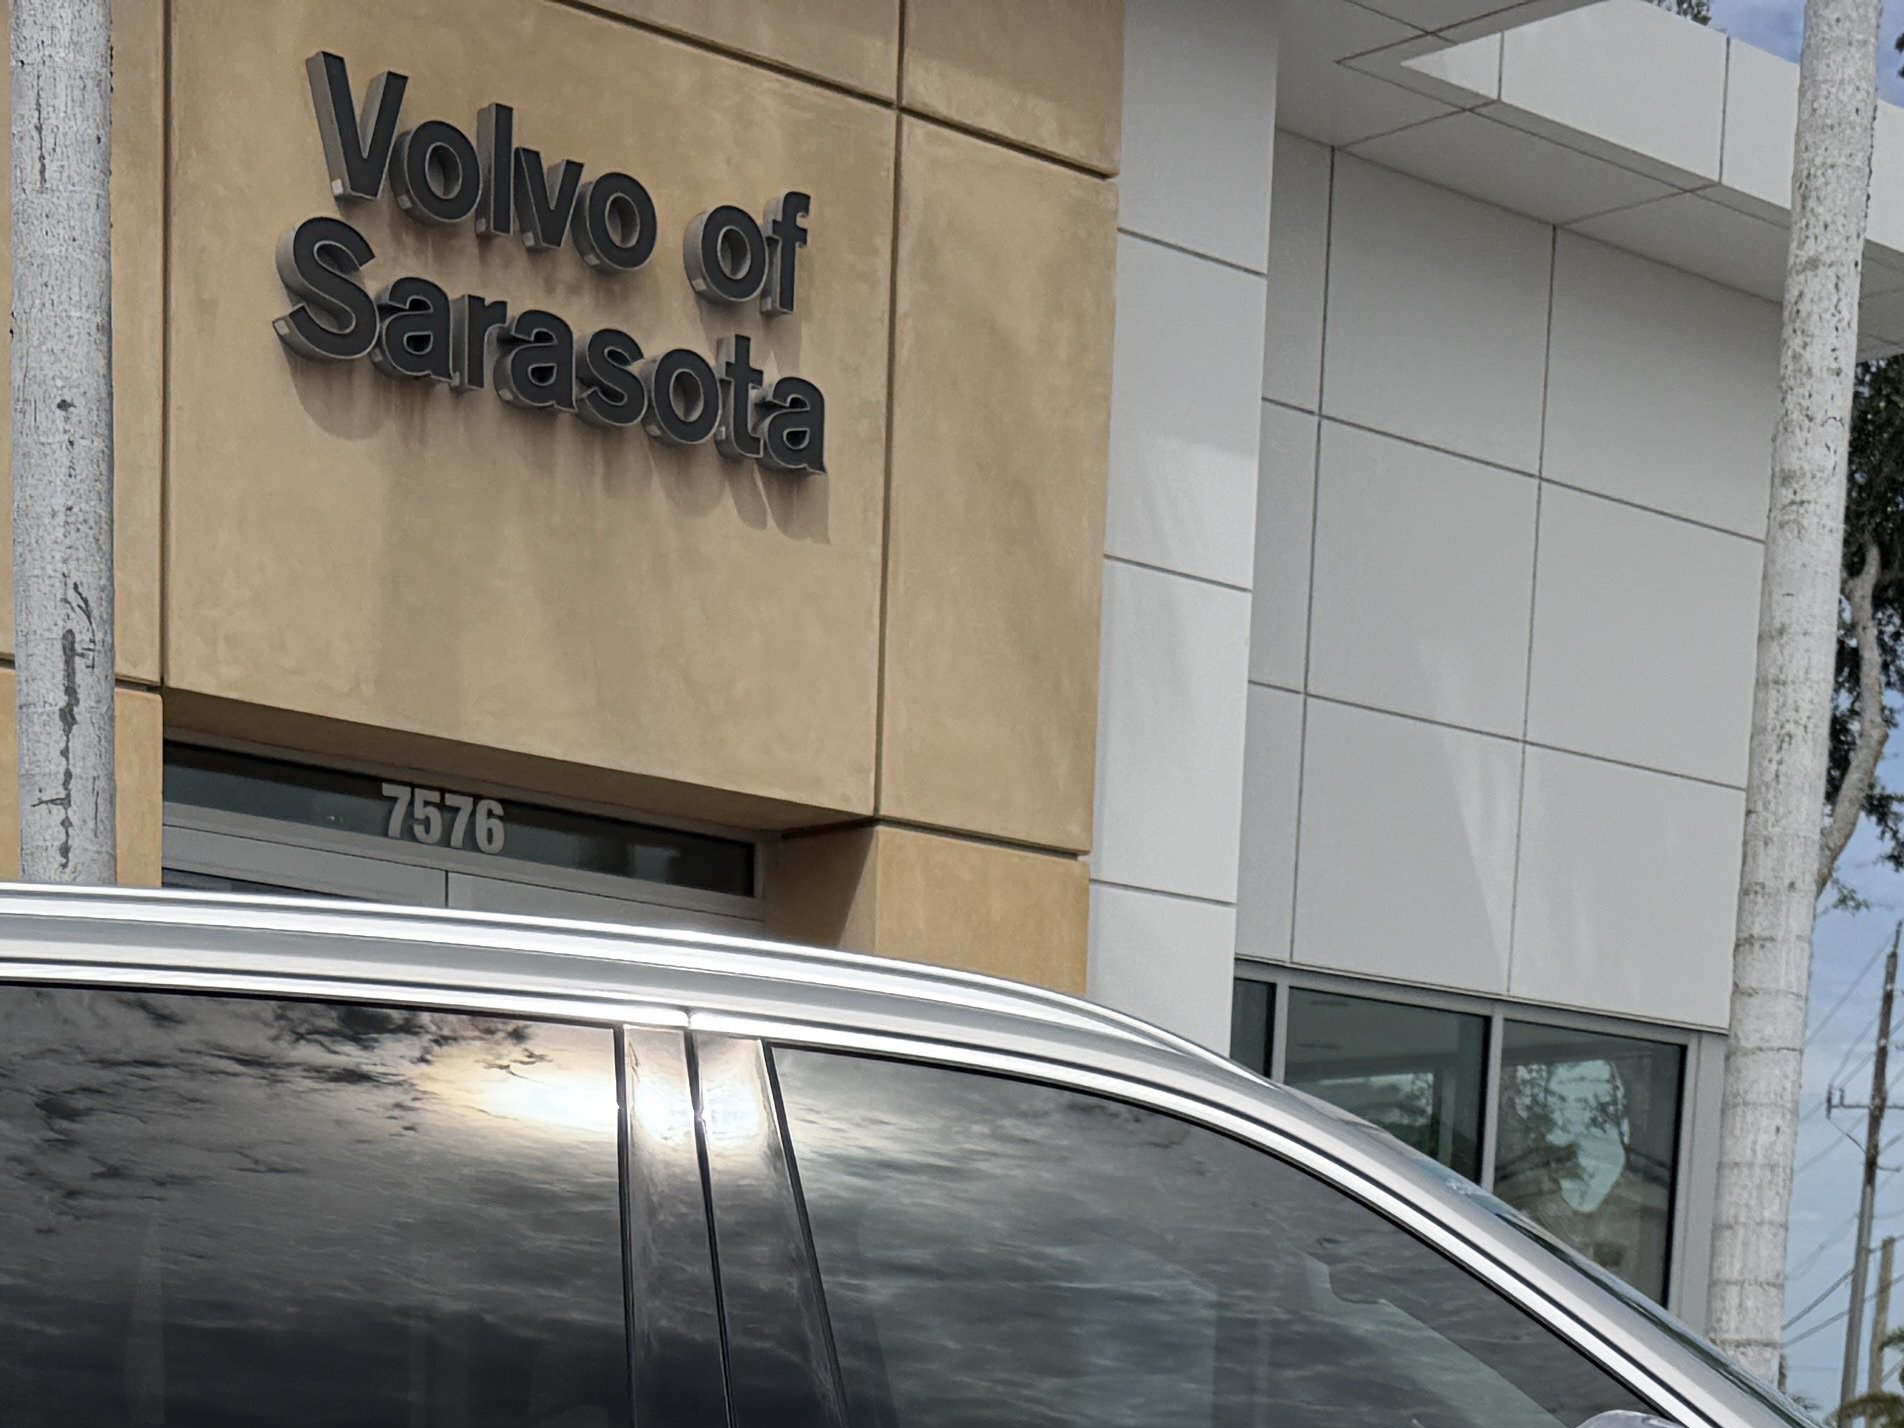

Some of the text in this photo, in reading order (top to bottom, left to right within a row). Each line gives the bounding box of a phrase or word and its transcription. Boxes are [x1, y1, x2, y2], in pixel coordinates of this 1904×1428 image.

[306, 51, 811, 315] Volvo of
[273, 216, 828, 475] Sarasota
[382, 782, 505, 854] 7576
